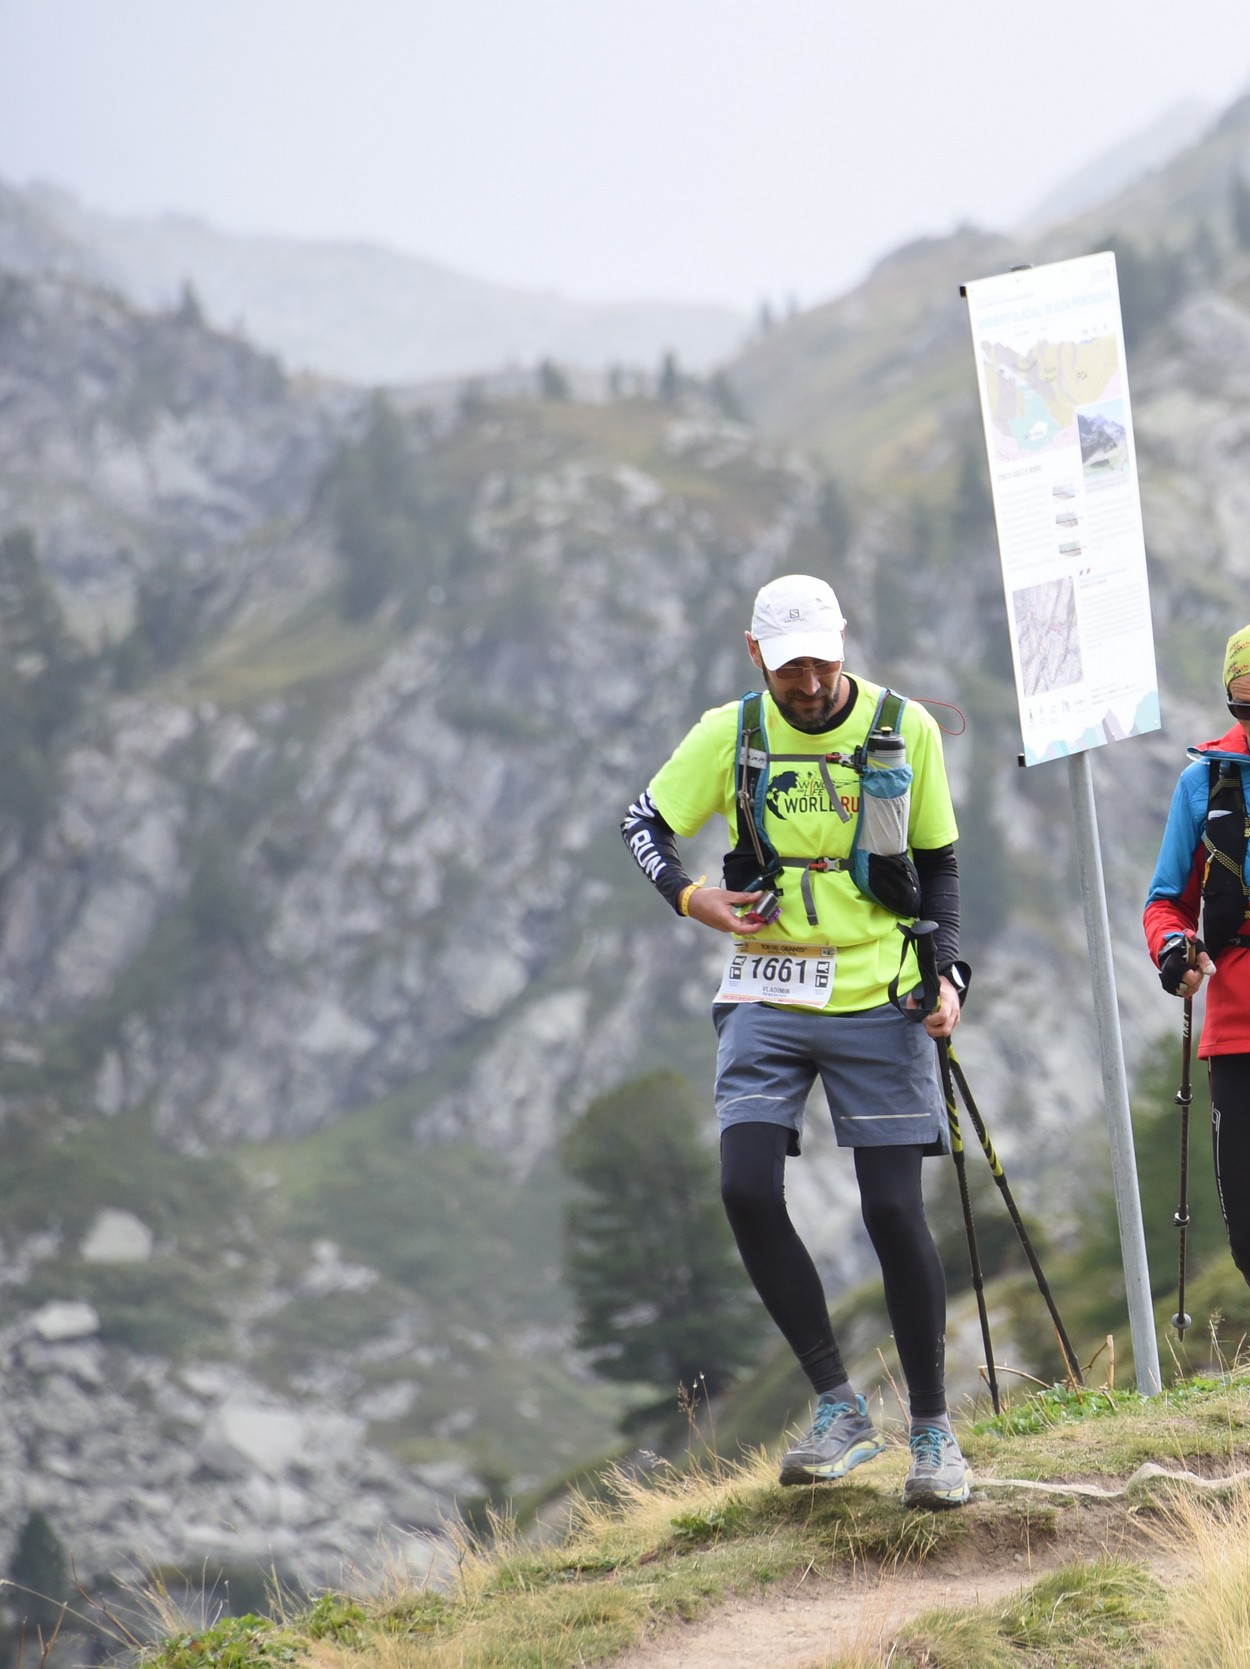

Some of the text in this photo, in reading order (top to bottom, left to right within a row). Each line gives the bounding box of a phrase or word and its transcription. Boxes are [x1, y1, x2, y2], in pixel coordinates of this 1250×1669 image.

[840, 796, 860, 813] RU
[630, 829, 667, 881] RUN
[751, 957, 807, 984] 1661
